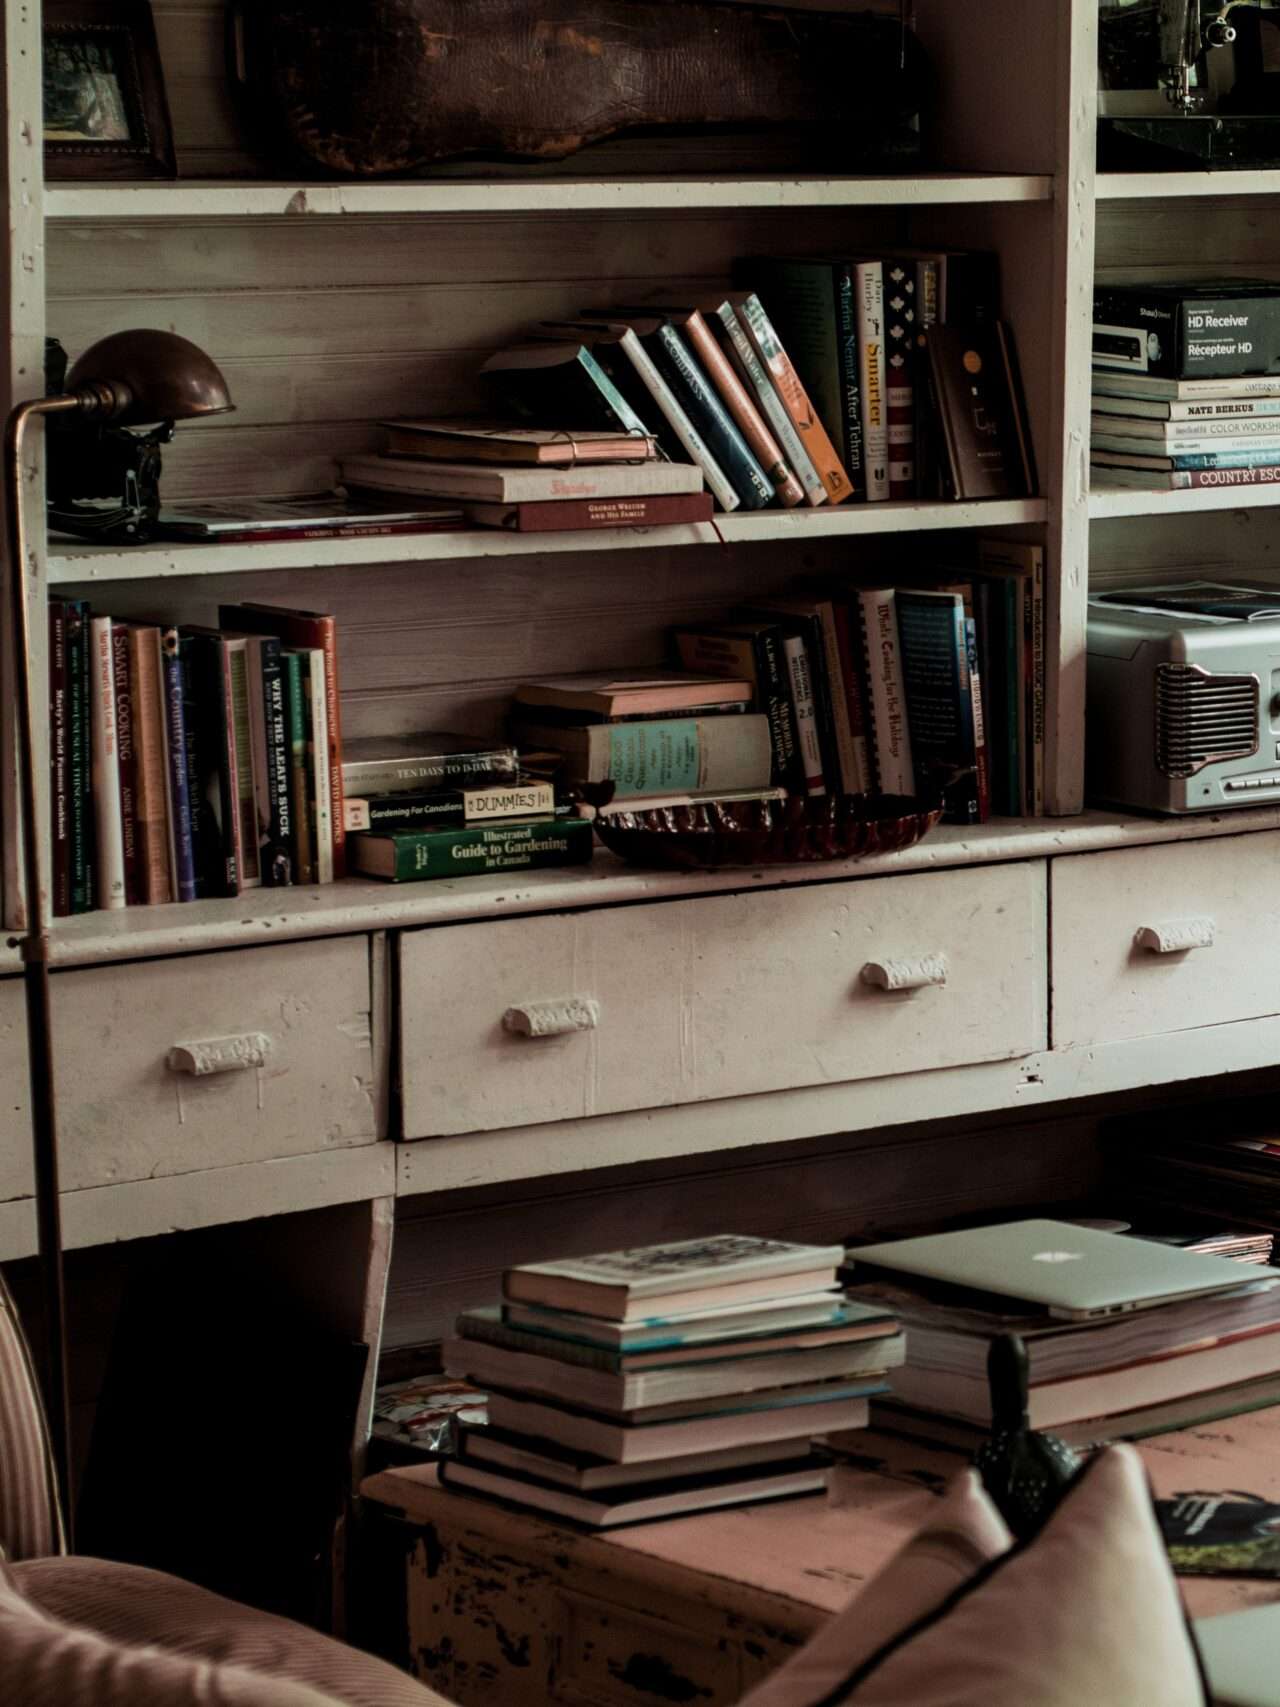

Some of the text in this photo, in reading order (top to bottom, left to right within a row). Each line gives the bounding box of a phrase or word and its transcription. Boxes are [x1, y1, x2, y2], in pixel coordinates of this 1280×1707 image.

[1188, 314, 1249, 328] HD Receiver
[1188, 342, 1252, 357] Récepteur HD
[867, 343, 883, 426] Smarter
[1187, 406, 1213, 415] NATE
[1216, 404, 1255, 413] BERKUS
[846, 384, 863, 470] After Tehran
[1210, 424, 1241, 434] COLOR
[1200, 471, 1256, 485] COUNTRY
[114, 635, 133, 760] SMART COOKING
[272, 678, 283, 711] WHY
[273, 714, 285, 744] THE
[397, 768, 418, 780] TEN
[419, 766, 445, 777] DAYS
[446, 764, 461, 775] TO
[330, 766, 340, 800] DAVID
[371, 808, 410, 818] Gardening
[424, 803, 463, 813] Canadians
[475, 792, 536, 812] DUMMIES
[278, 795, 290, 837] SUCK
[483, 828, 532, 842] Illustrated
[451, 837, 568, 859] Guide to Gardening
[486, 854, 531, 868] in Canada
